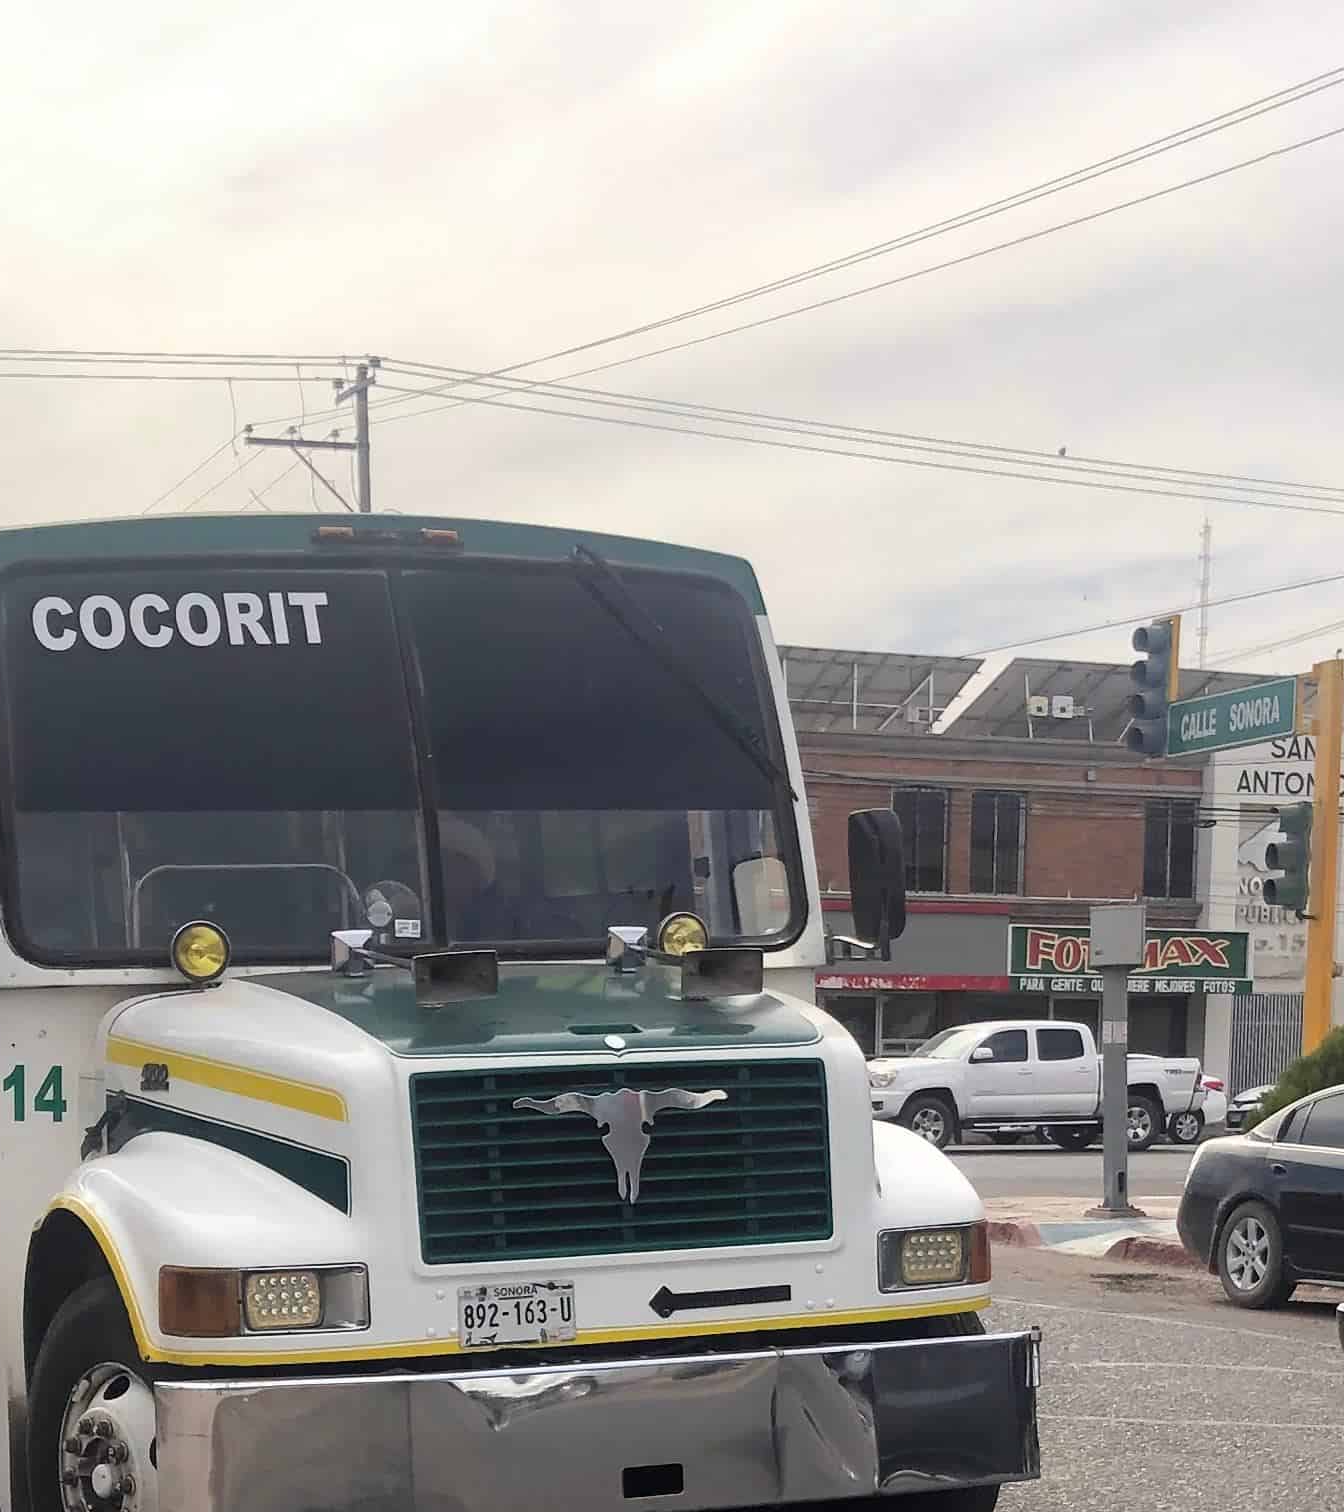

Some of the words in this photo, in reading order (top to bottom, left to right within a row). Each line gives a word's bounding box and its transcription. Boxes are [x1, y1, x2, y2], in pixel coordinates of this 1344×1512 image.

[32, 592, 329, 651] COCORIT
[1180, 708, 1217, 742] CALLE
[1228, 695, 1281, 733] SONORA
[1019, 977, 1045, 991] PARA
[1090, 979, 1104, 992] QU
[1154, 980, 1196, 993] MEJORES
[1203, 981, 1236, 993] FOTOS
[2, 1064, 68, 1123] 14
[494, 1285, 538, 1297] SONORA
[463, 1296, 572, 1330] 892-163-U
